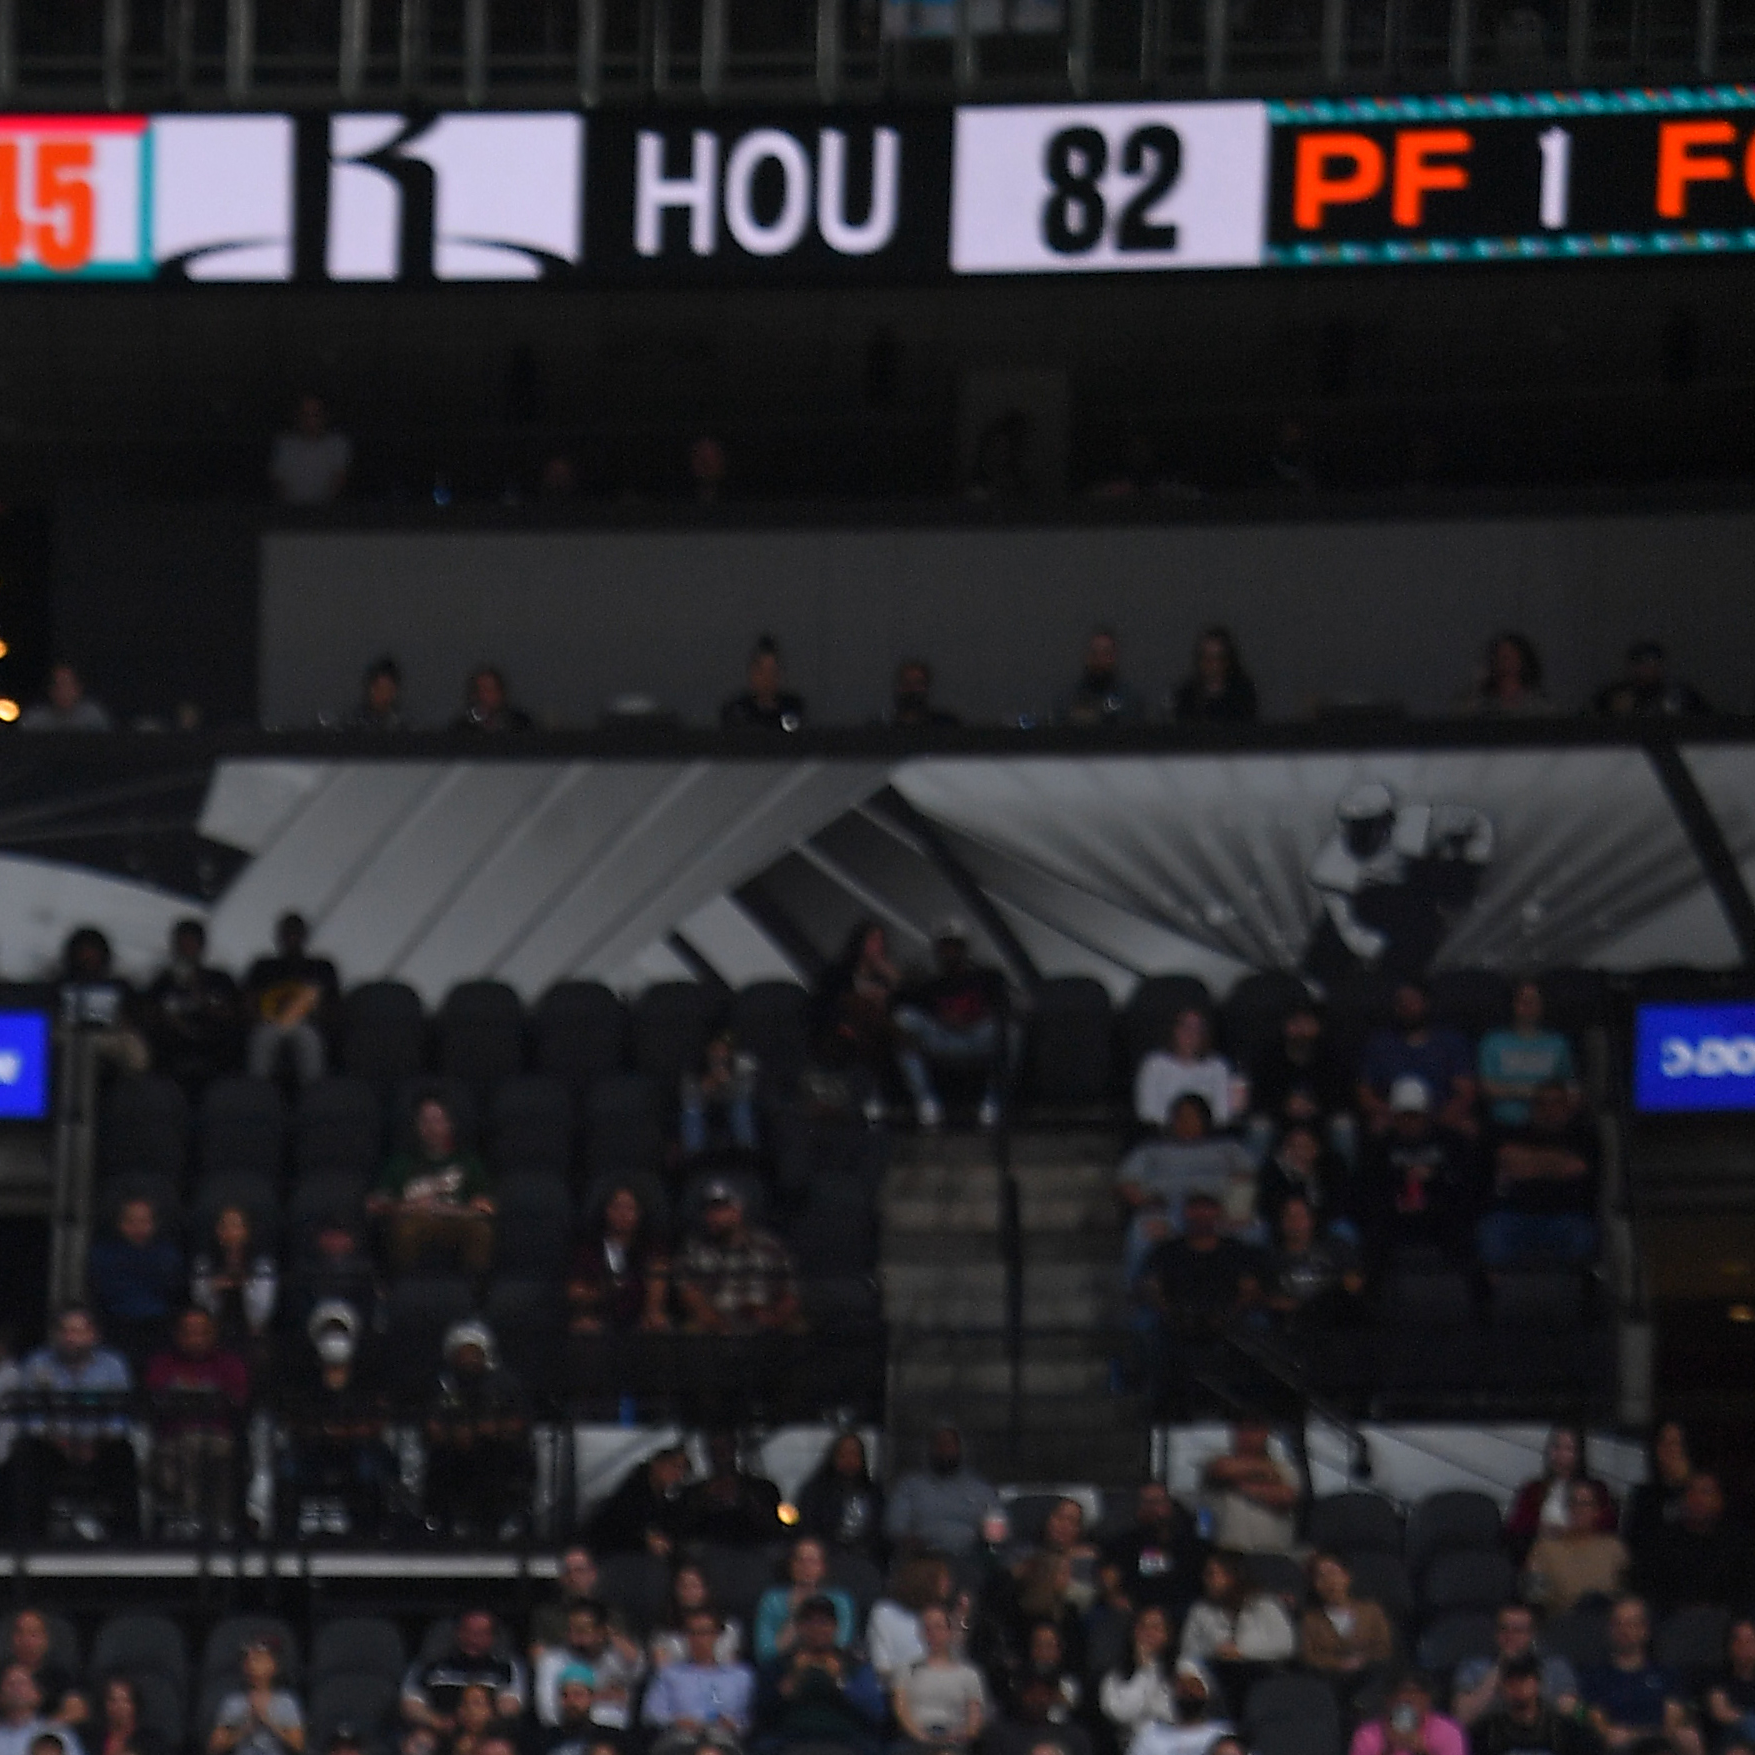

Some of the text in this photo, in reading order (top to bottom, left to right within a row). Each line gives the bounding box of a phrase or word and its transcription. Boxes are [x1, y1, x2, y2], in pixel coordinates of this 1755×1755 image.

[634, 122, 1183, 257] HOU 82
[1293, 129, 1473, 230] PF
[1656, 119, 1755, 220] F
